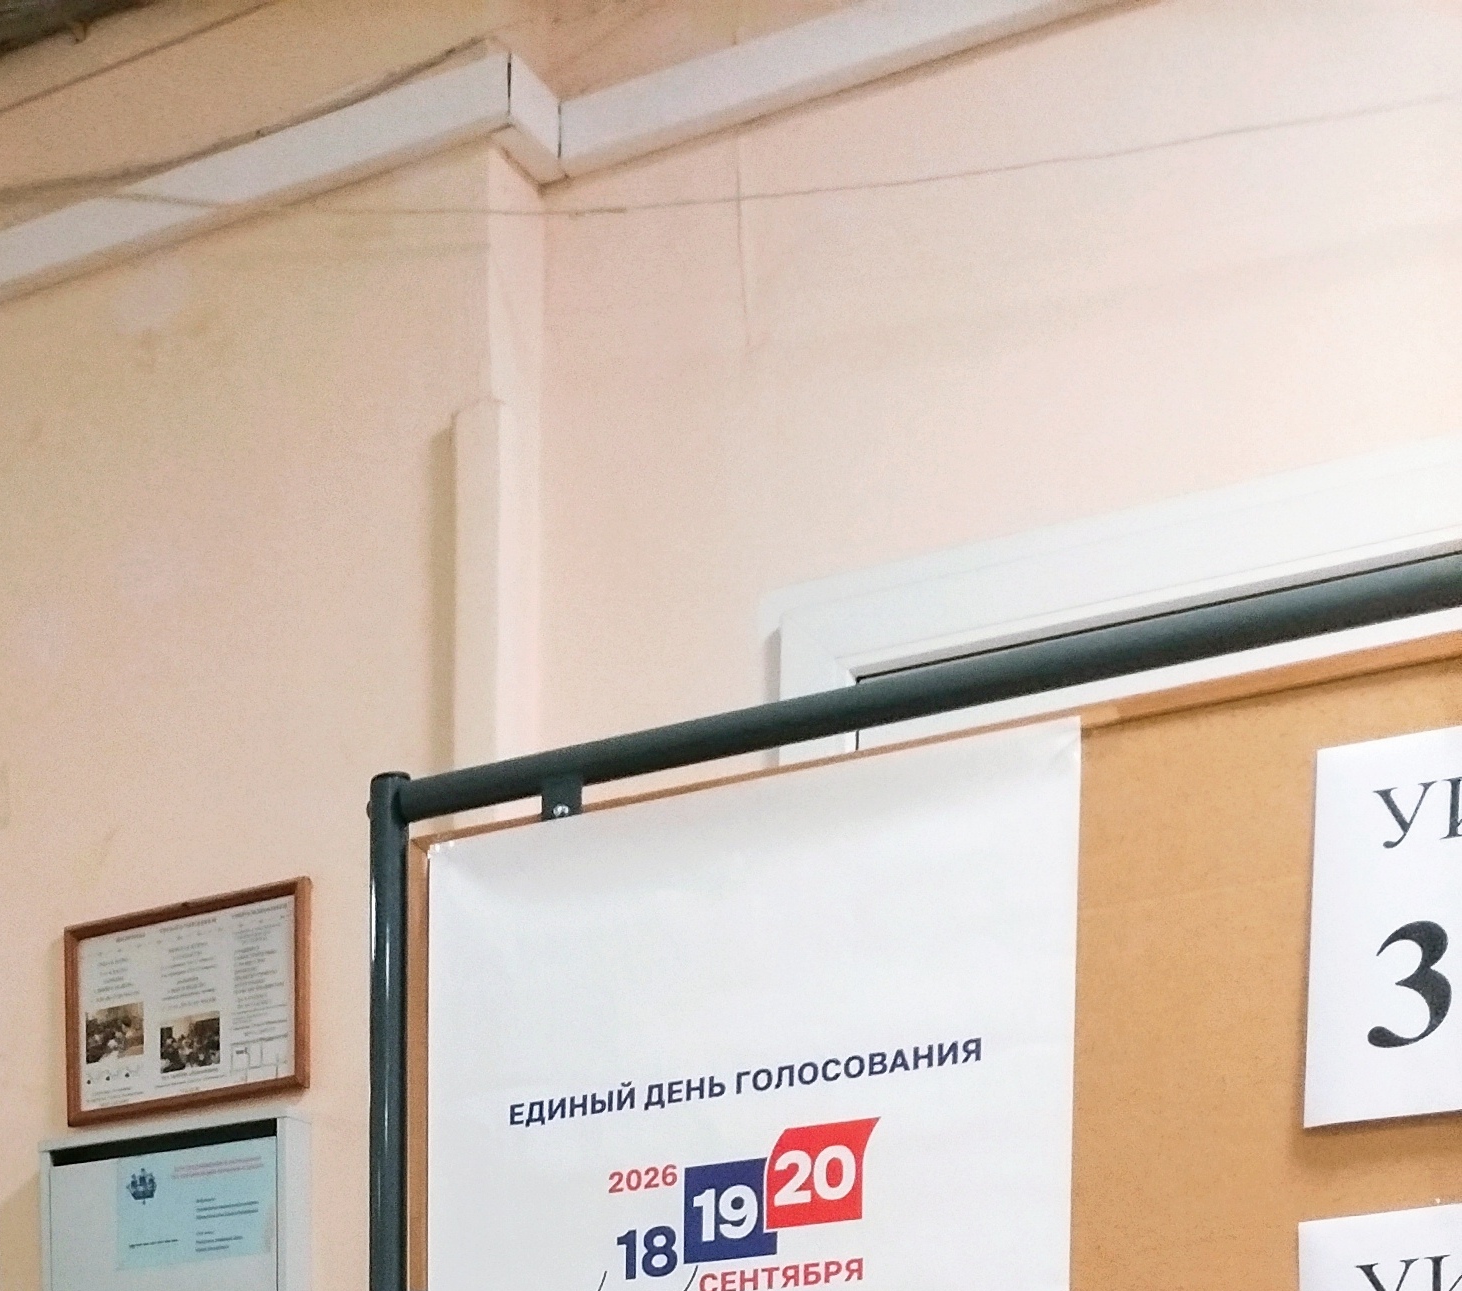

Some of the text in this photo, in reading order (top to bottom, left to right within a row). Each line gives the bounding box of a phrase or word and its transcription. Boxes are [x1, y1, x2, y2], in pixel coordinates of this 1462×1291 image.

[509, 1037, 982, 1127] ЕДИНЫЙ ДЕНЬ ГОЛОСОВАНИЯ
[608, 1164, 678, 1194] 2026
[616, 1144, 856, 1280] 18 19 20
